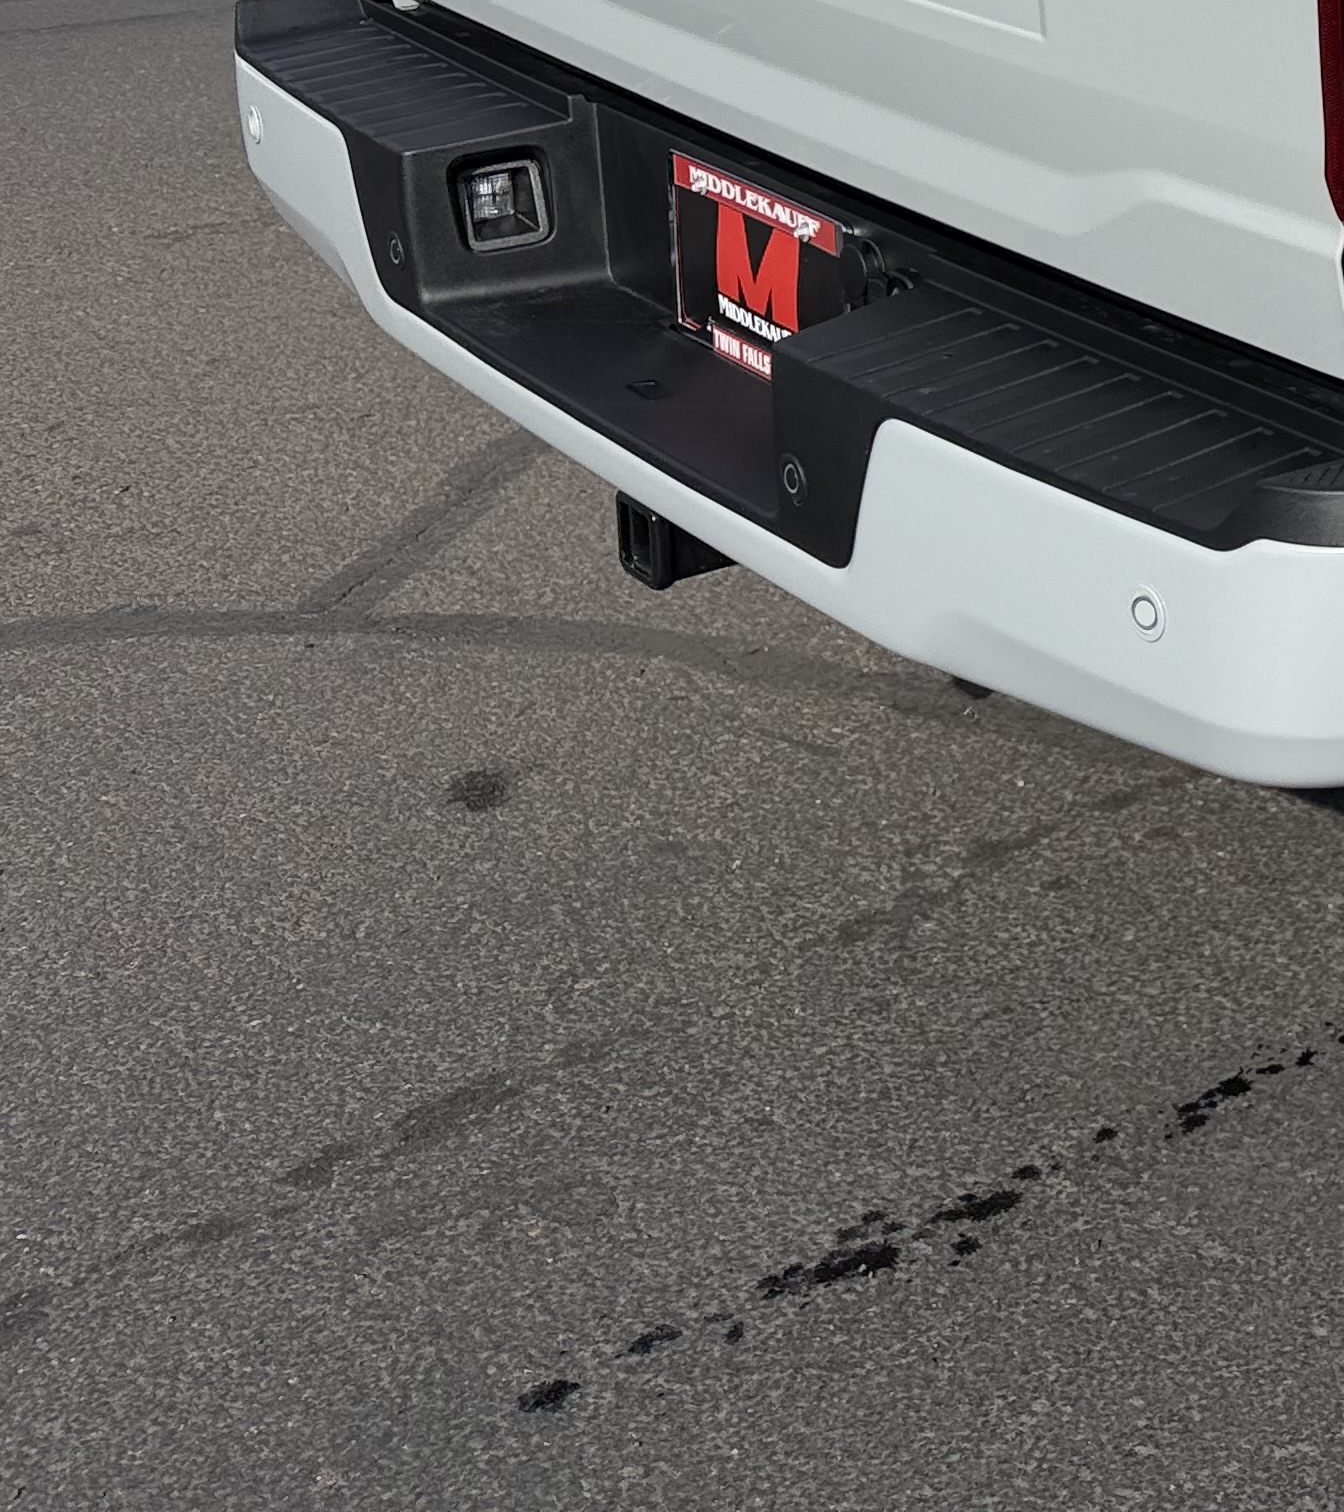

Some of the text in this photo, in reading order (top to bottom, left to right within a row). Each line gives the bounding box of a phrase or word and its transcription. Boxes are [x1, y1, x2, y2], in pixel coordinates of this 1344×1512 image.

[688, 164, 821, 238] MIDDLEKAUFF
[716, 203, 799, 334] M
[712, 327, 773, 376] TWIN FALLS
